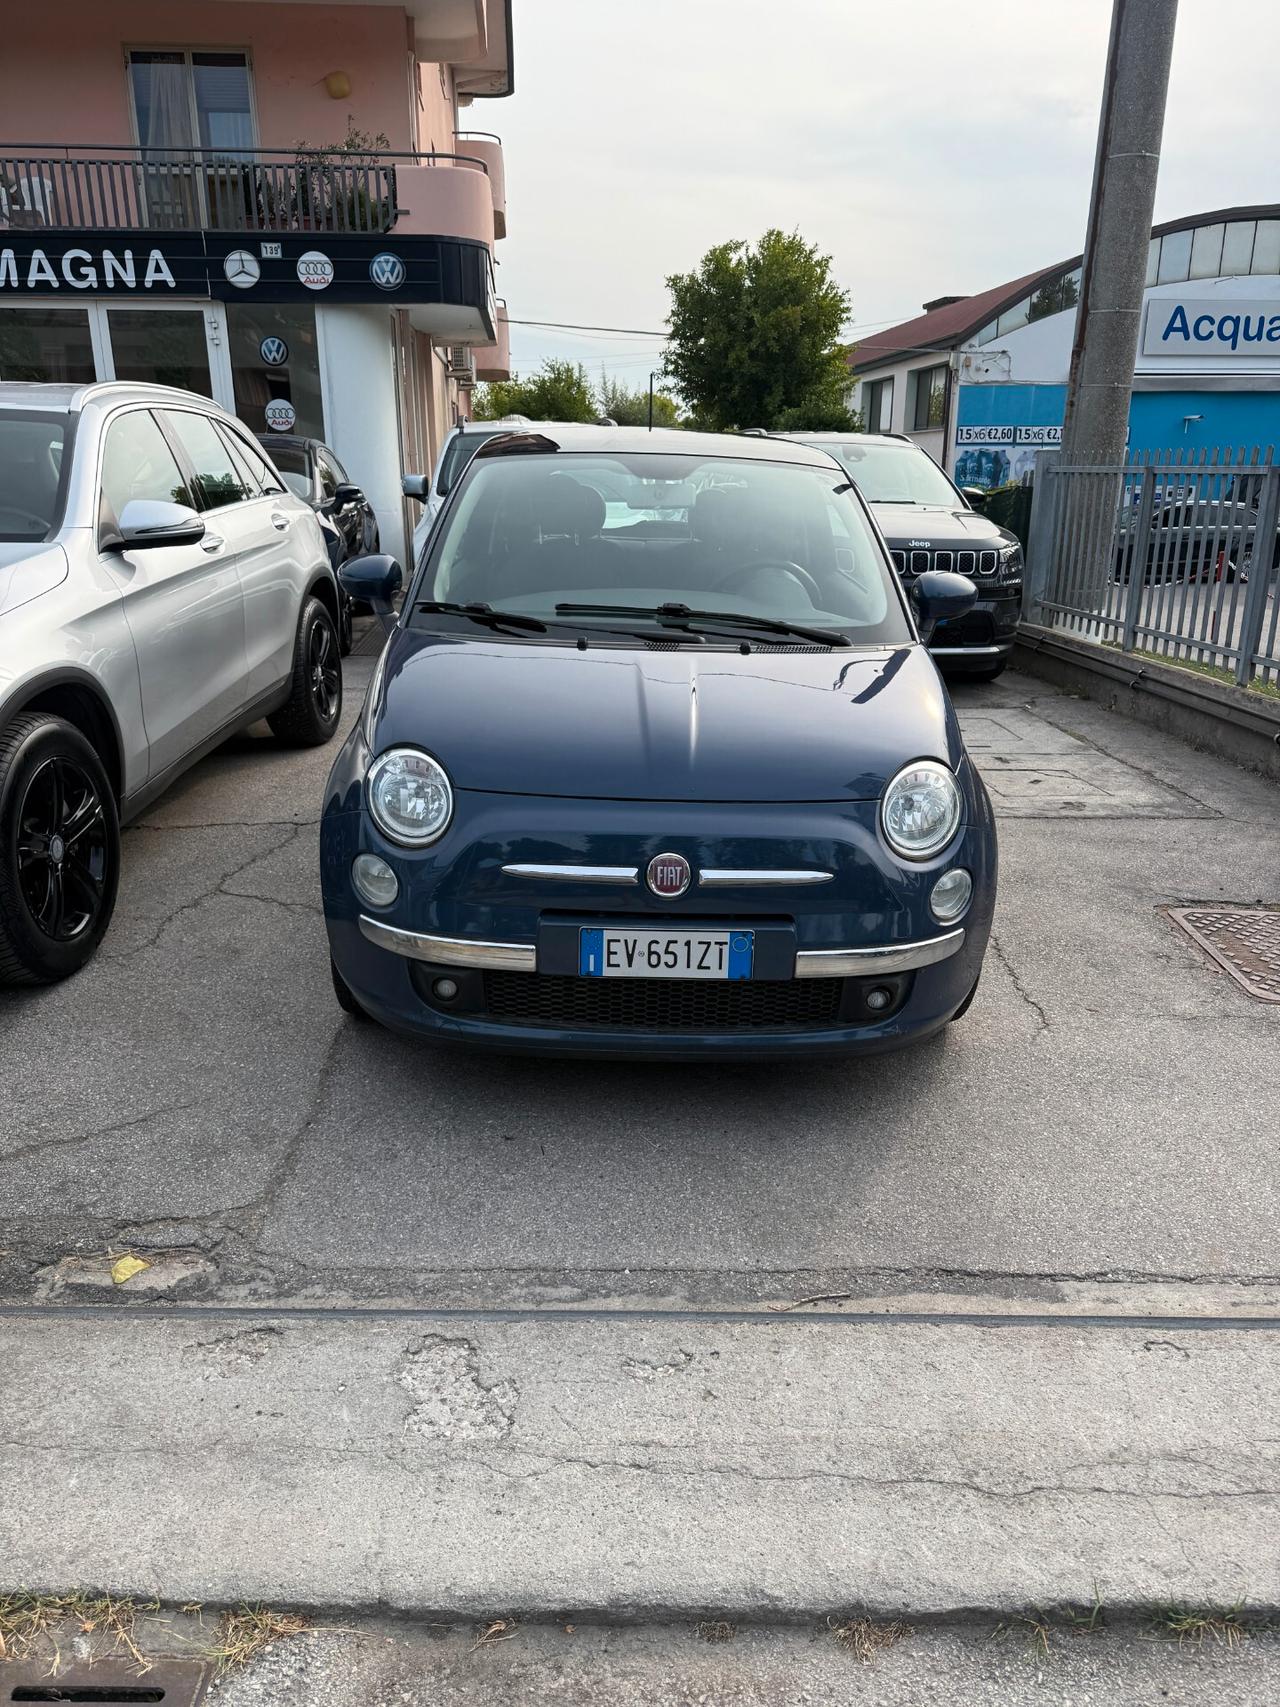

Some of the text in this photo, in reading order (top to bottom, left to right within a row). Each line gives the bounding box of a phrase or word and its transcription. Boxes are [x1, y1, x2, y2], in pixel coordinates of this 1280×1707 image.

[303, 276, 330, 284] Audi
[909, 540, 931, 548] Jeep
[656, 866, 683, 886] FIAT
